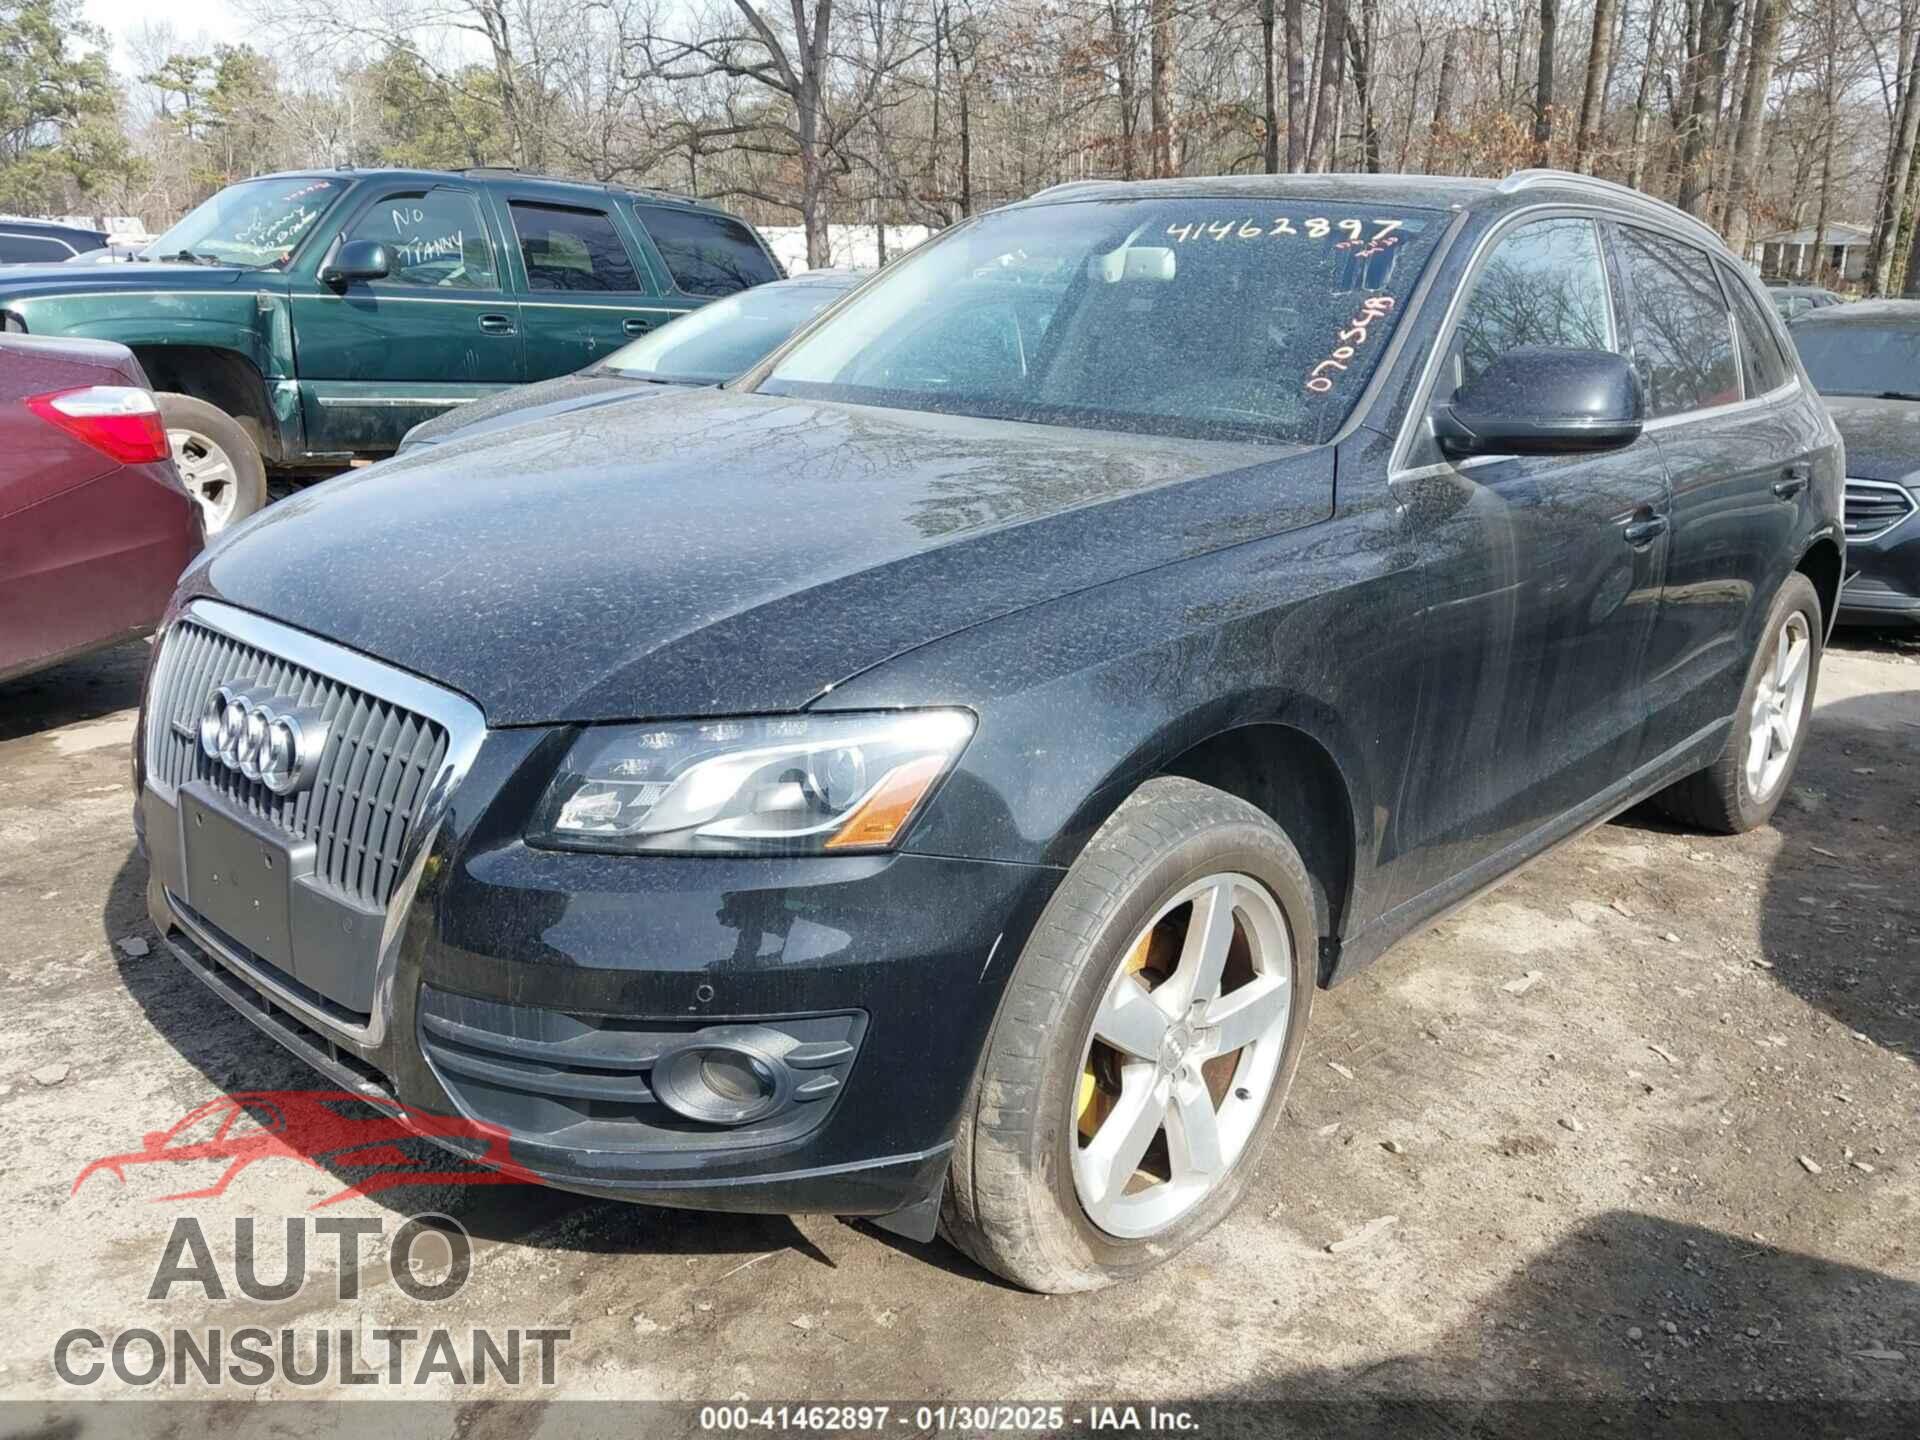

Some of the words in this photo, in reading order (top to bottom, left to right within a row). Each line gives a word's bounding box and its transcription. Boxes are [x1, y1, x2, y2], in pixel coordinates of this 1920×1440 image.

[391, 207, 424, 235] NO
[1167, 217, 1402, 243] 41462897
[1306, 295, 1396, 392] 070548
